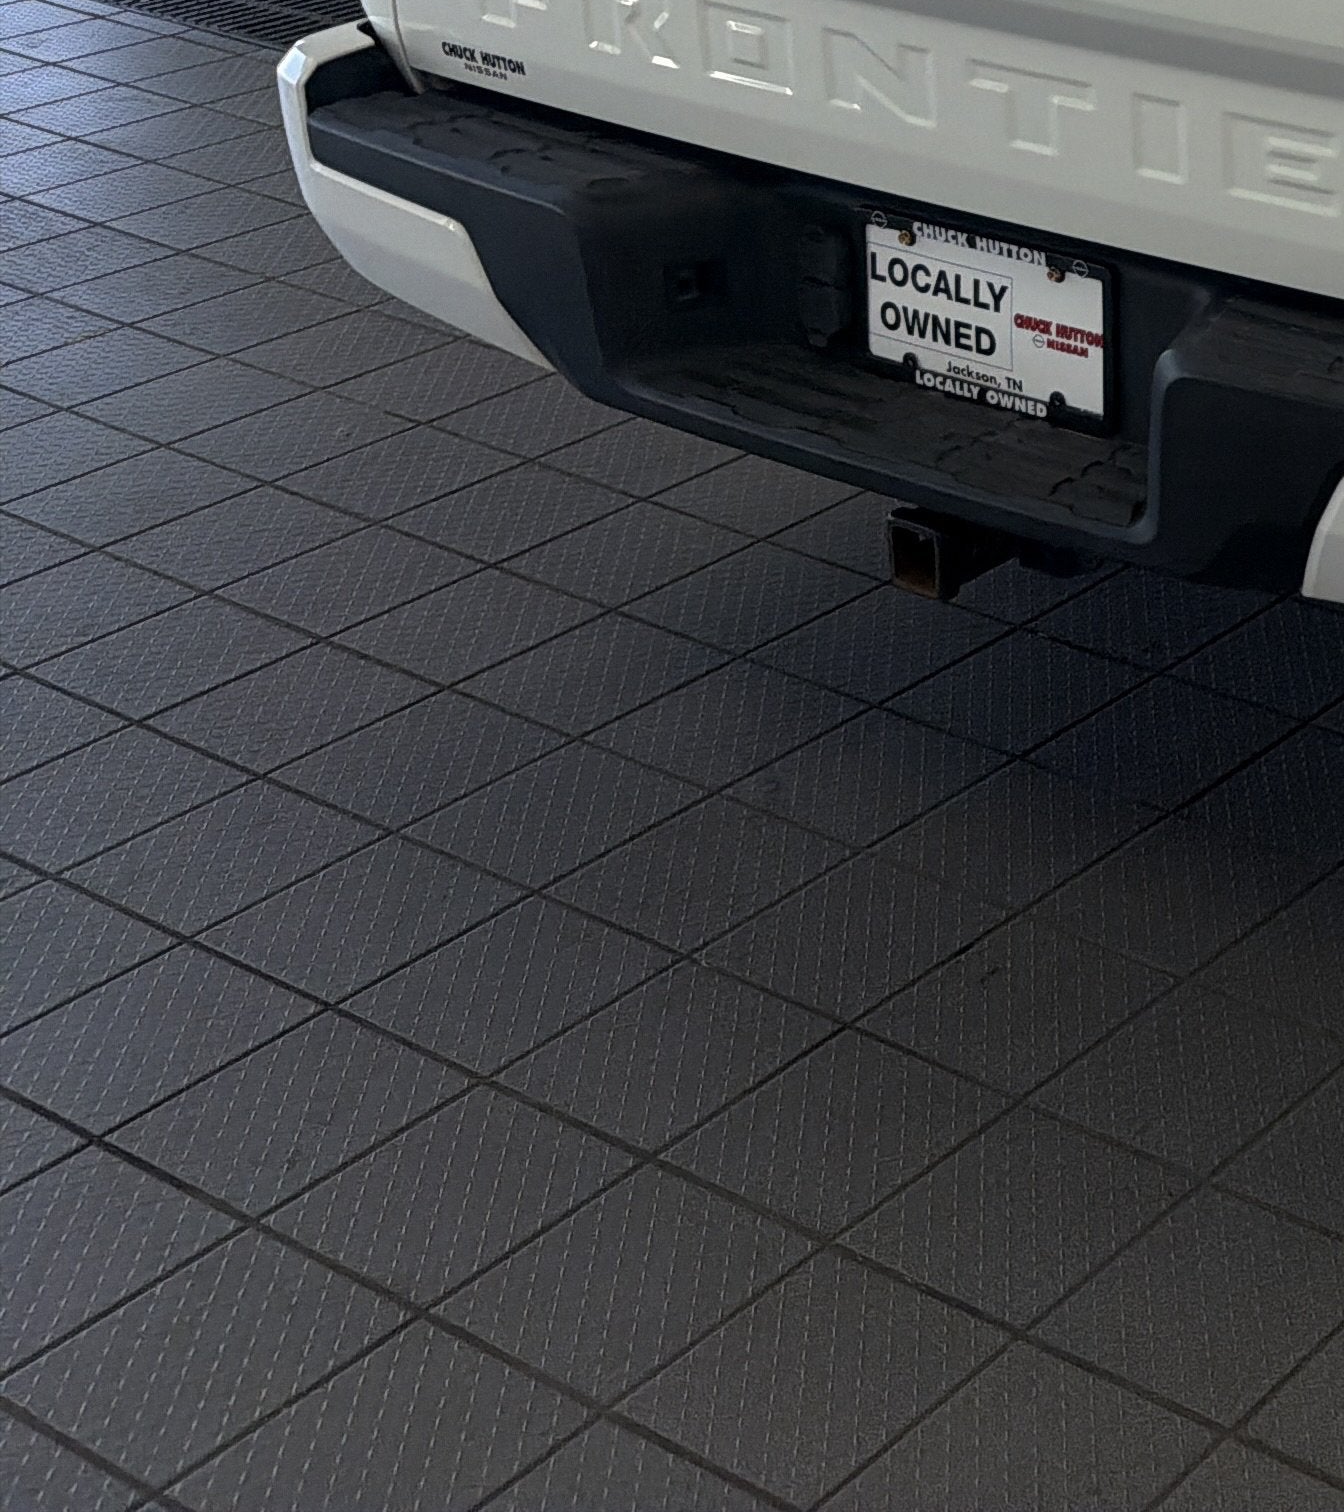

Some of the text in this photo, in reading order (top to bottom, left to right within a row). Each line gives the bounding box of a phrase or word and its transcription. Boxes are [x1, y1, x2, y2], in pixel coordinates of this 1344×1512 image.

[441, 42, 526, 75] CHUCK HUTTON
[464, 63, 508, 80] NISSAN
[912, 222, 1047, 267] CHUCK HUTTON
[870, 251, 1009, 313] LOCALLY
[880, 301, 997, 356] OWNED
[1014, 312, 1053, 336] CHUCK
[915, 369, 1048, 418] LOCALLY OWNED
[946, 361, 1023, 393] Jackson, TN
